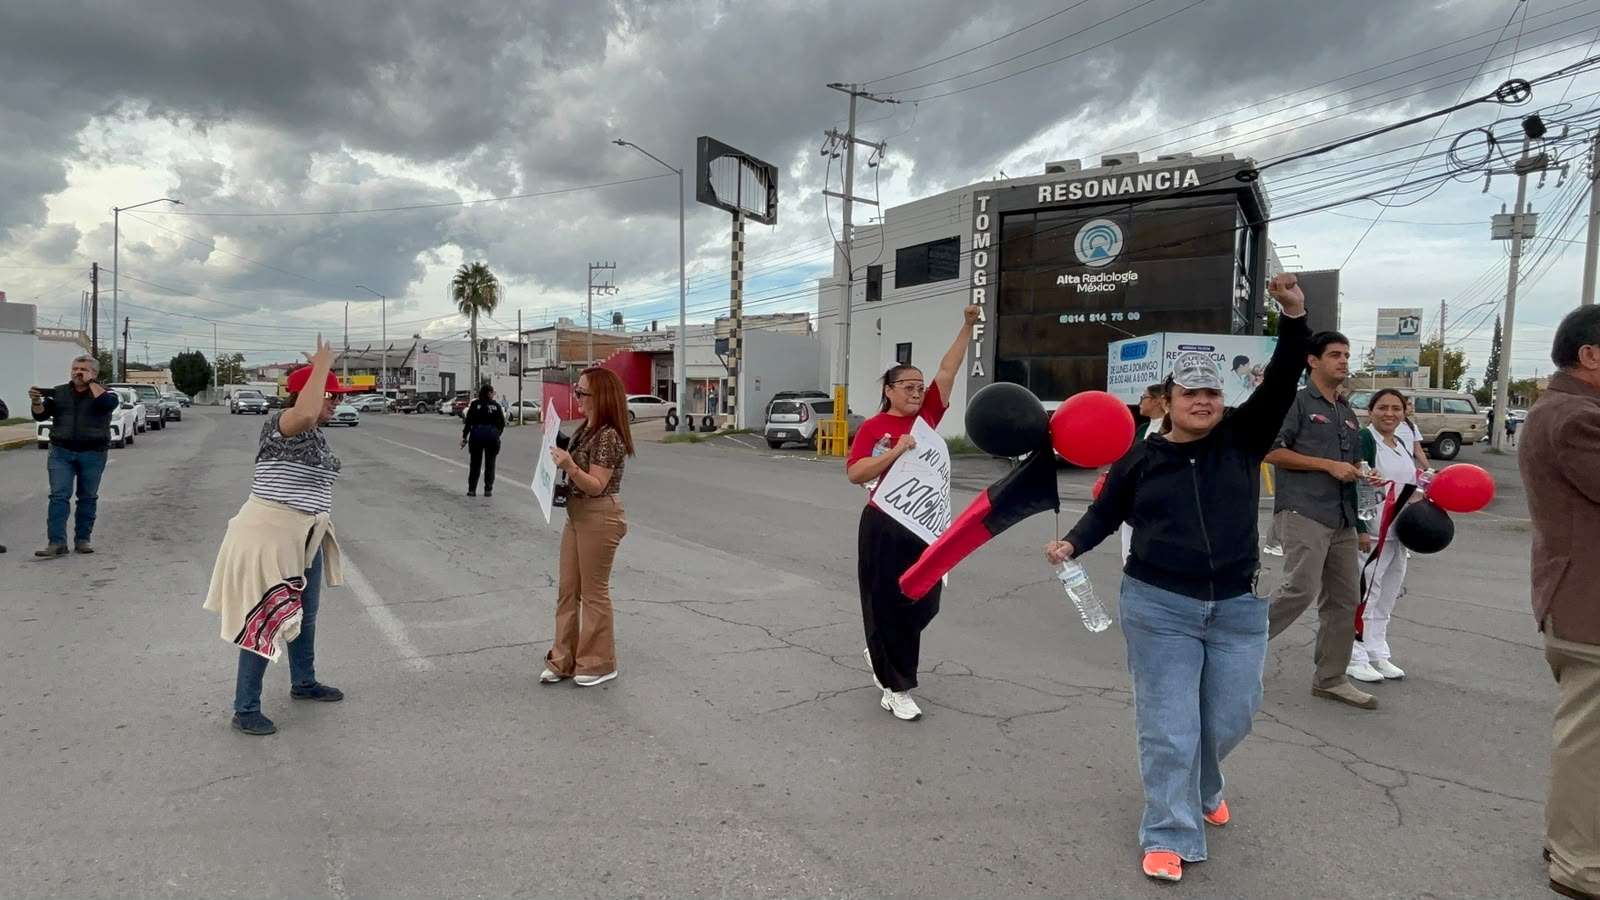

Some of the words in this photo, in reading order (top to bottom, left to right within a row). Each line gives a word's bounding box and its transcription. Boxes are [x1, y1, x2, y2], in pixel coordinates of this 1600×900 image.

[1037, 168, 1200, 204] RESONANCIA
[1057, 274, 1081, 285] Alta
[1082, 270, 1138, 283] Radiología
[1077, 282, 1116, 293] México
[1128, 311, 1140, 321] 00
[919, 448, 941, 467] NO
